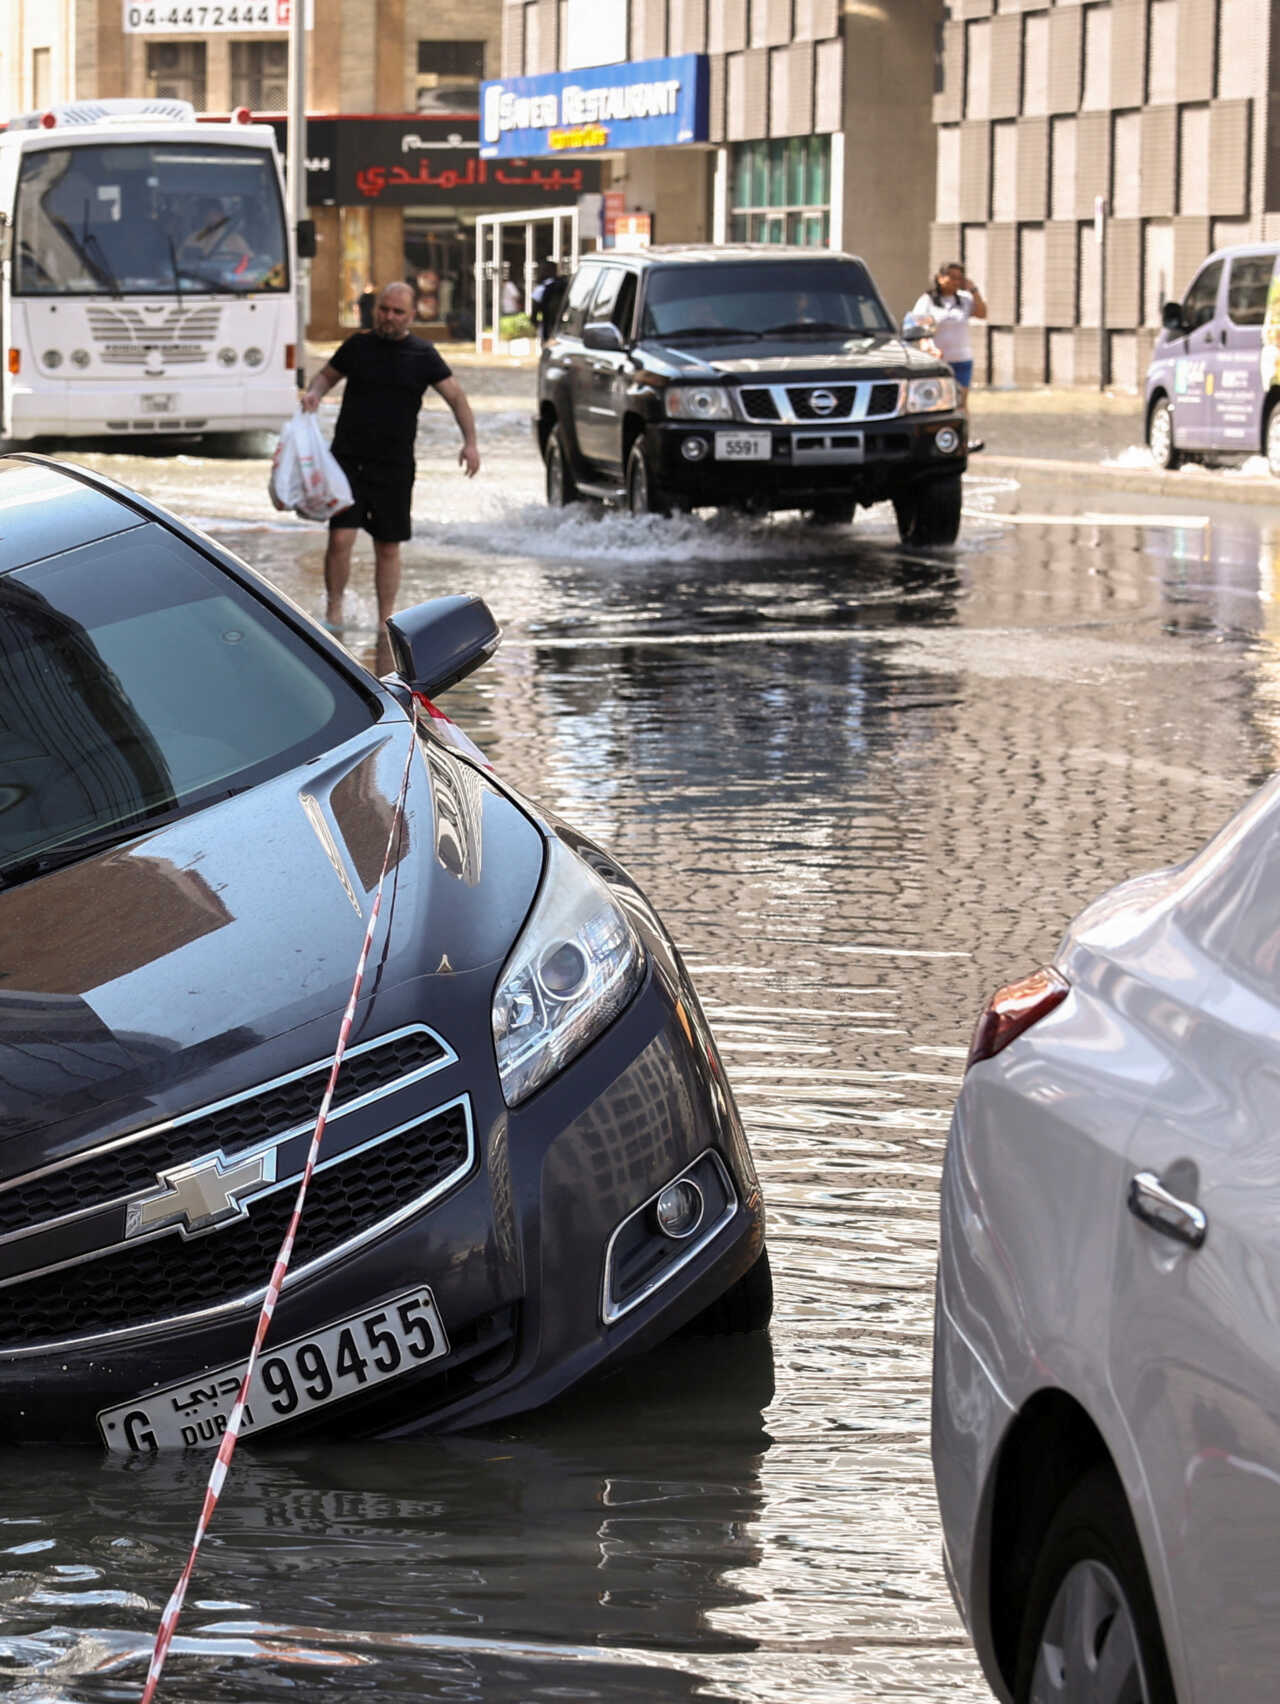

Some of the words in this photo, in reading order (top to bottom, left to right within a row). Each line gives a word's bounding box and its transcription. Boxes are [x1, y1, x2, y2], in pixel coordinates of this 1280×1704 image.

[129, 6, 269, 27] 04-4472444
[561, 79, 680, 124] RESTAURANT
[356, 157, 487, 197] المندي
[494, 159, 583, 190] بيت
[726, 440, 758, 456] 5591
[261, 1298, 436, 1415] 99455
[172, 1377, 242, 1417] دبي
[123, 1410, 158, 1450] G
[181, 1404, 255, 1446] DUBI
